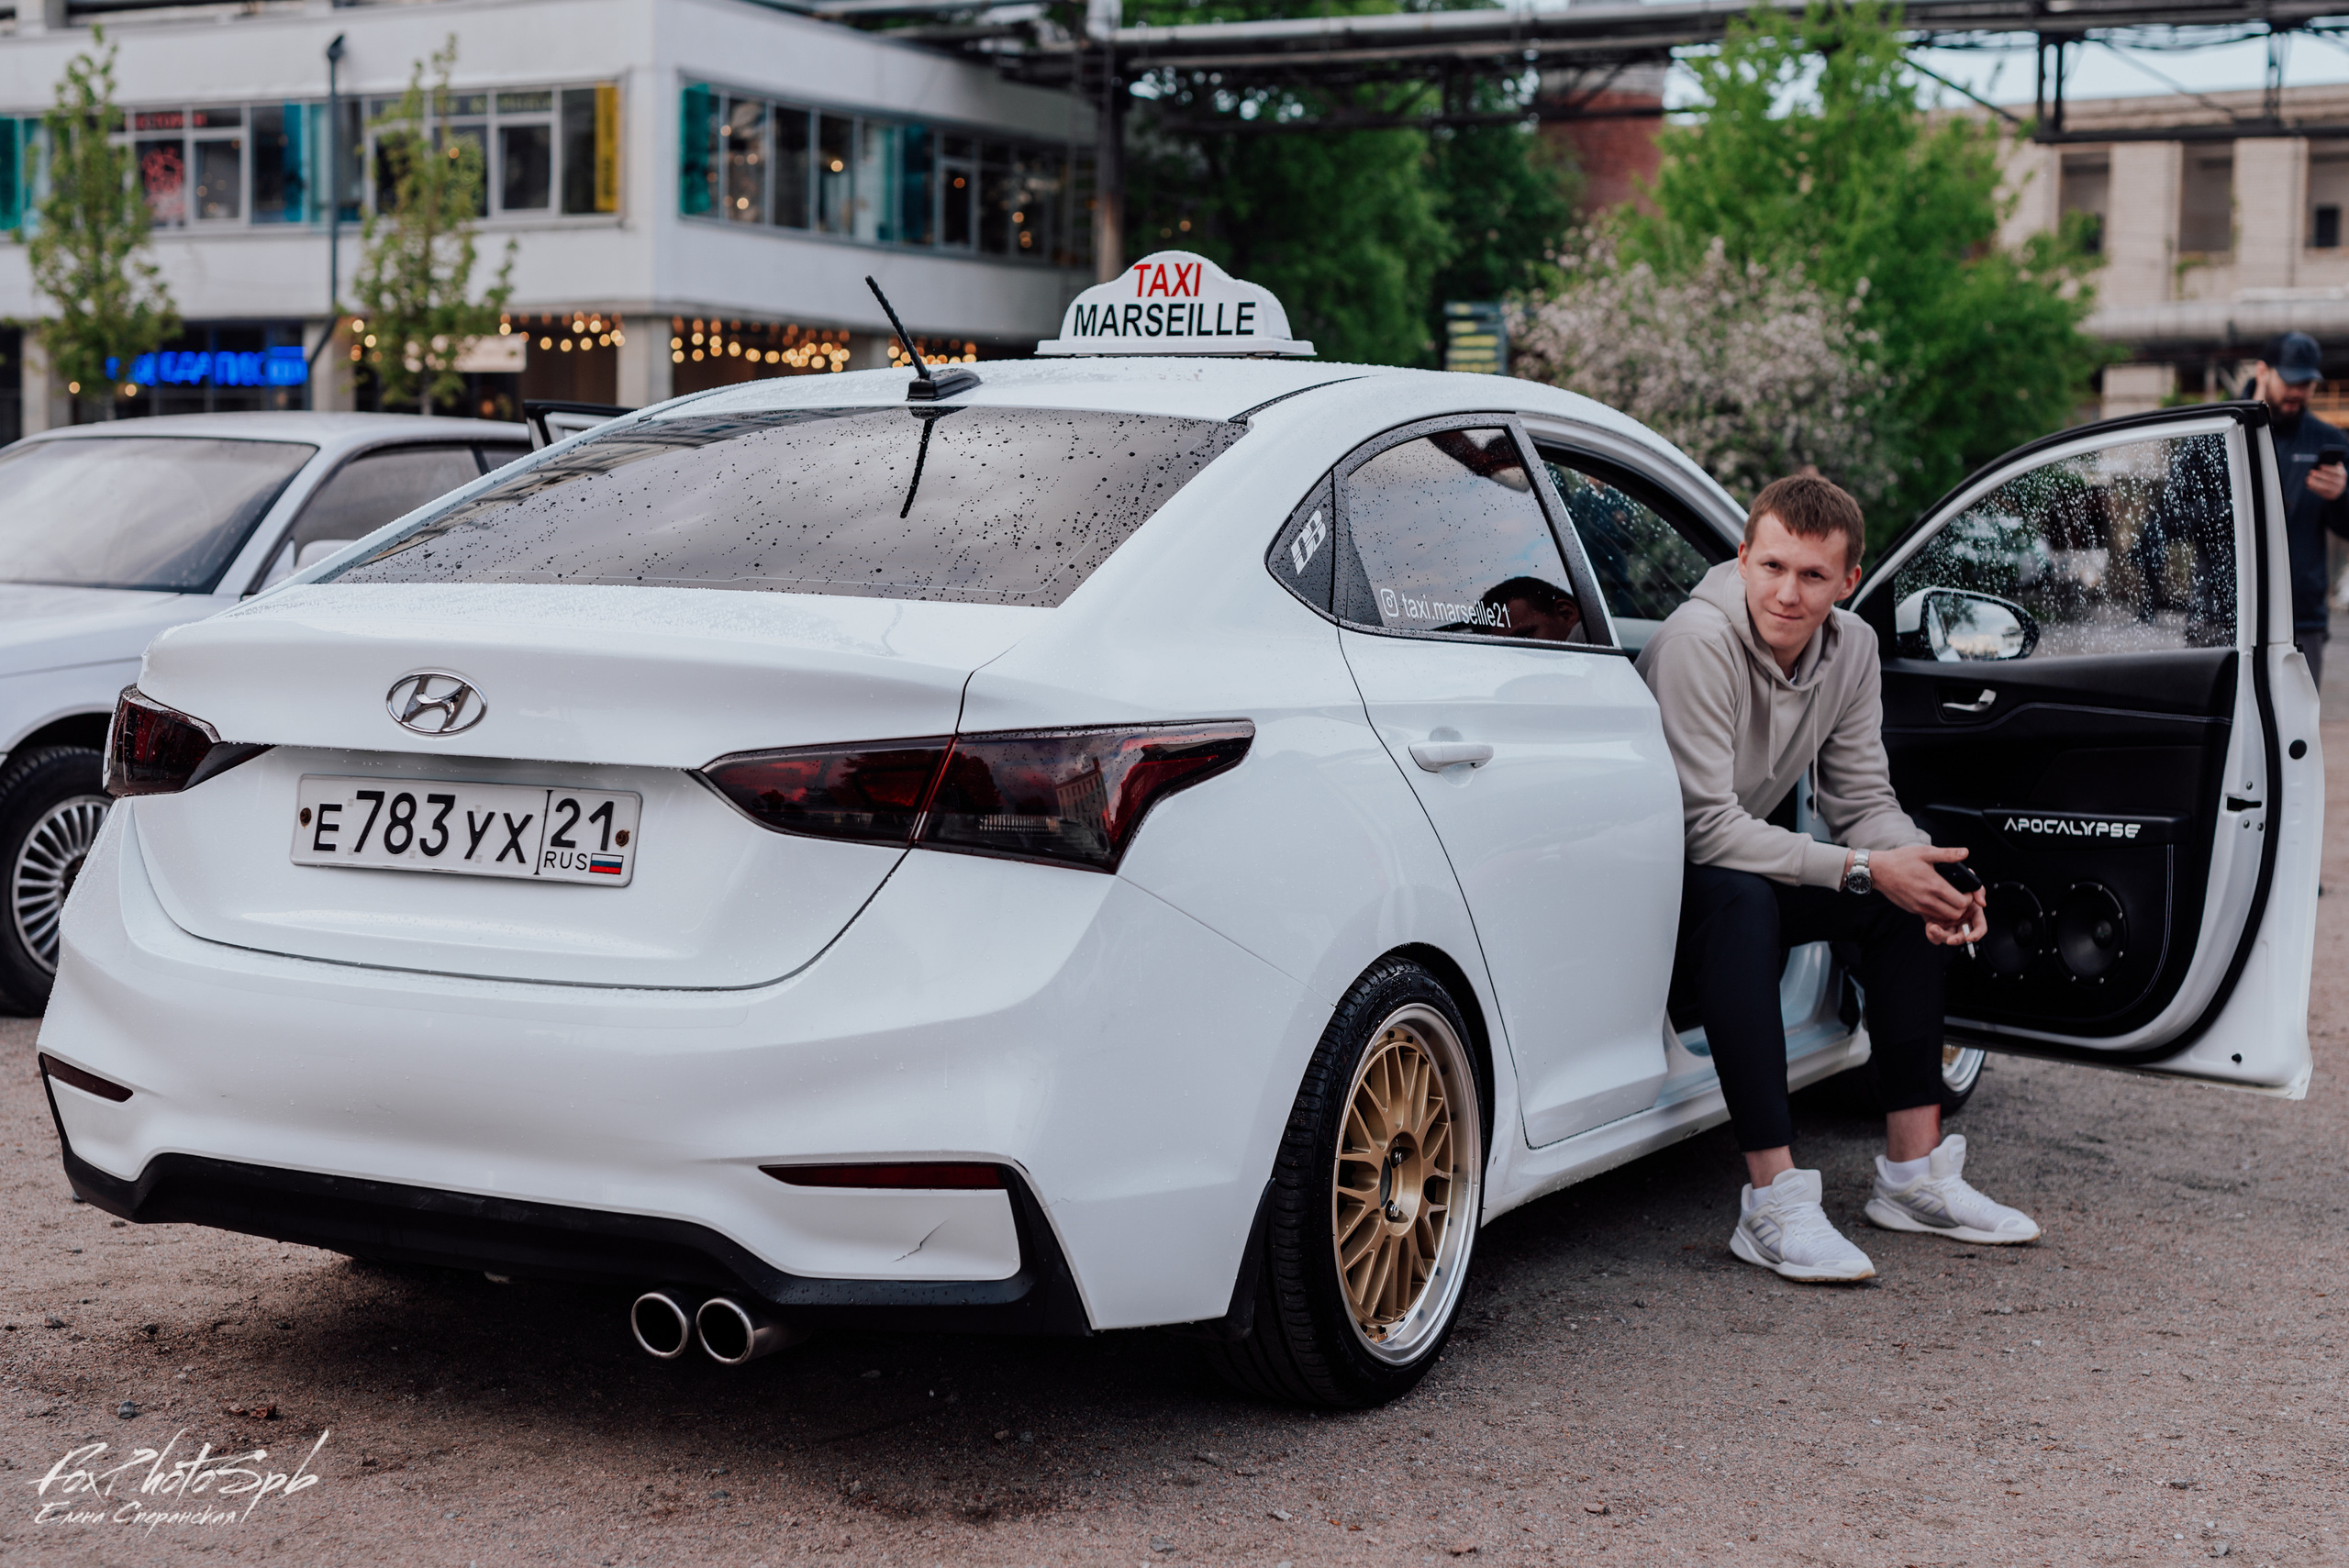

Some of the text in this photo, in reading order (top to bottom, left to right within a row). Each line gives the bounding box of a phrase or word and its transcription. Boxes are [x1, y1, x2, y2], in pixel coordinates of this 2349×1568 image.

[1133, 262, 1202, 298] TAXI
[1073, 301, 1256, 338] MARSEILLE
[1401, 593, 1512, 628] taxi.marseille21
[550, 797, 615, 851] 21
[2003, 817, 2142, 839] APOCALYPSE
[543, 851, 588, 872] RUS
